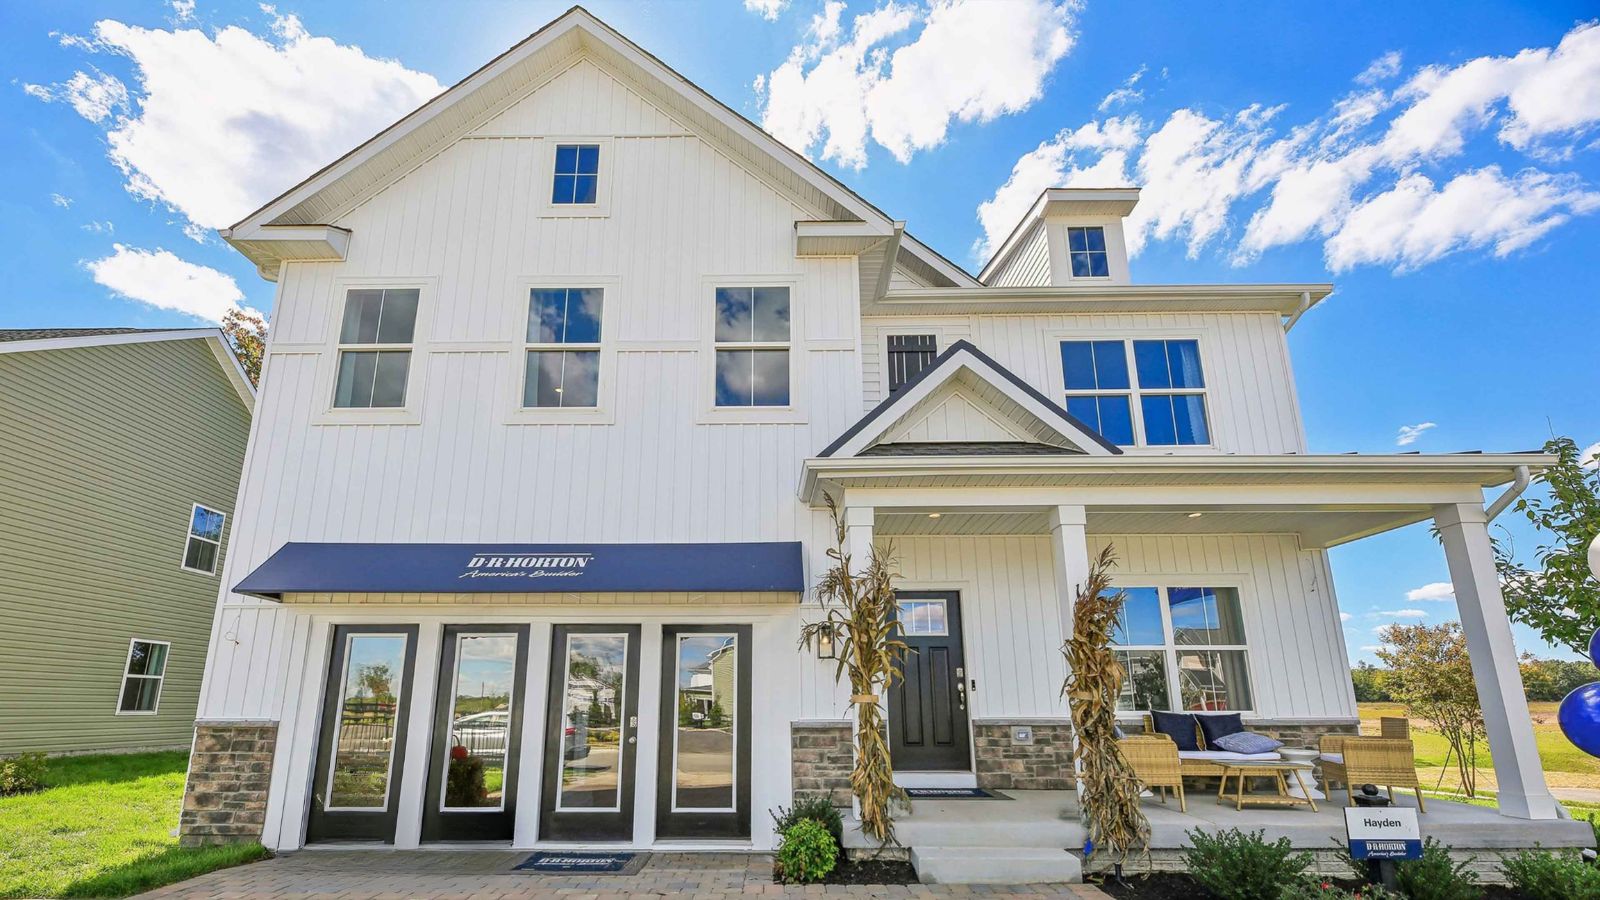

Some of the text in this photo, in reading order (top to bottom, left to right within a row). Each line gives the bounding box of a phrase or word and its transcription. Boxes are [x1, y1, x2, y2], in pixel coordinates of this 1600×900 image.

[458, 569, 584, 579] America's Builder
[1364, 818, 1402, 829] Hayden
